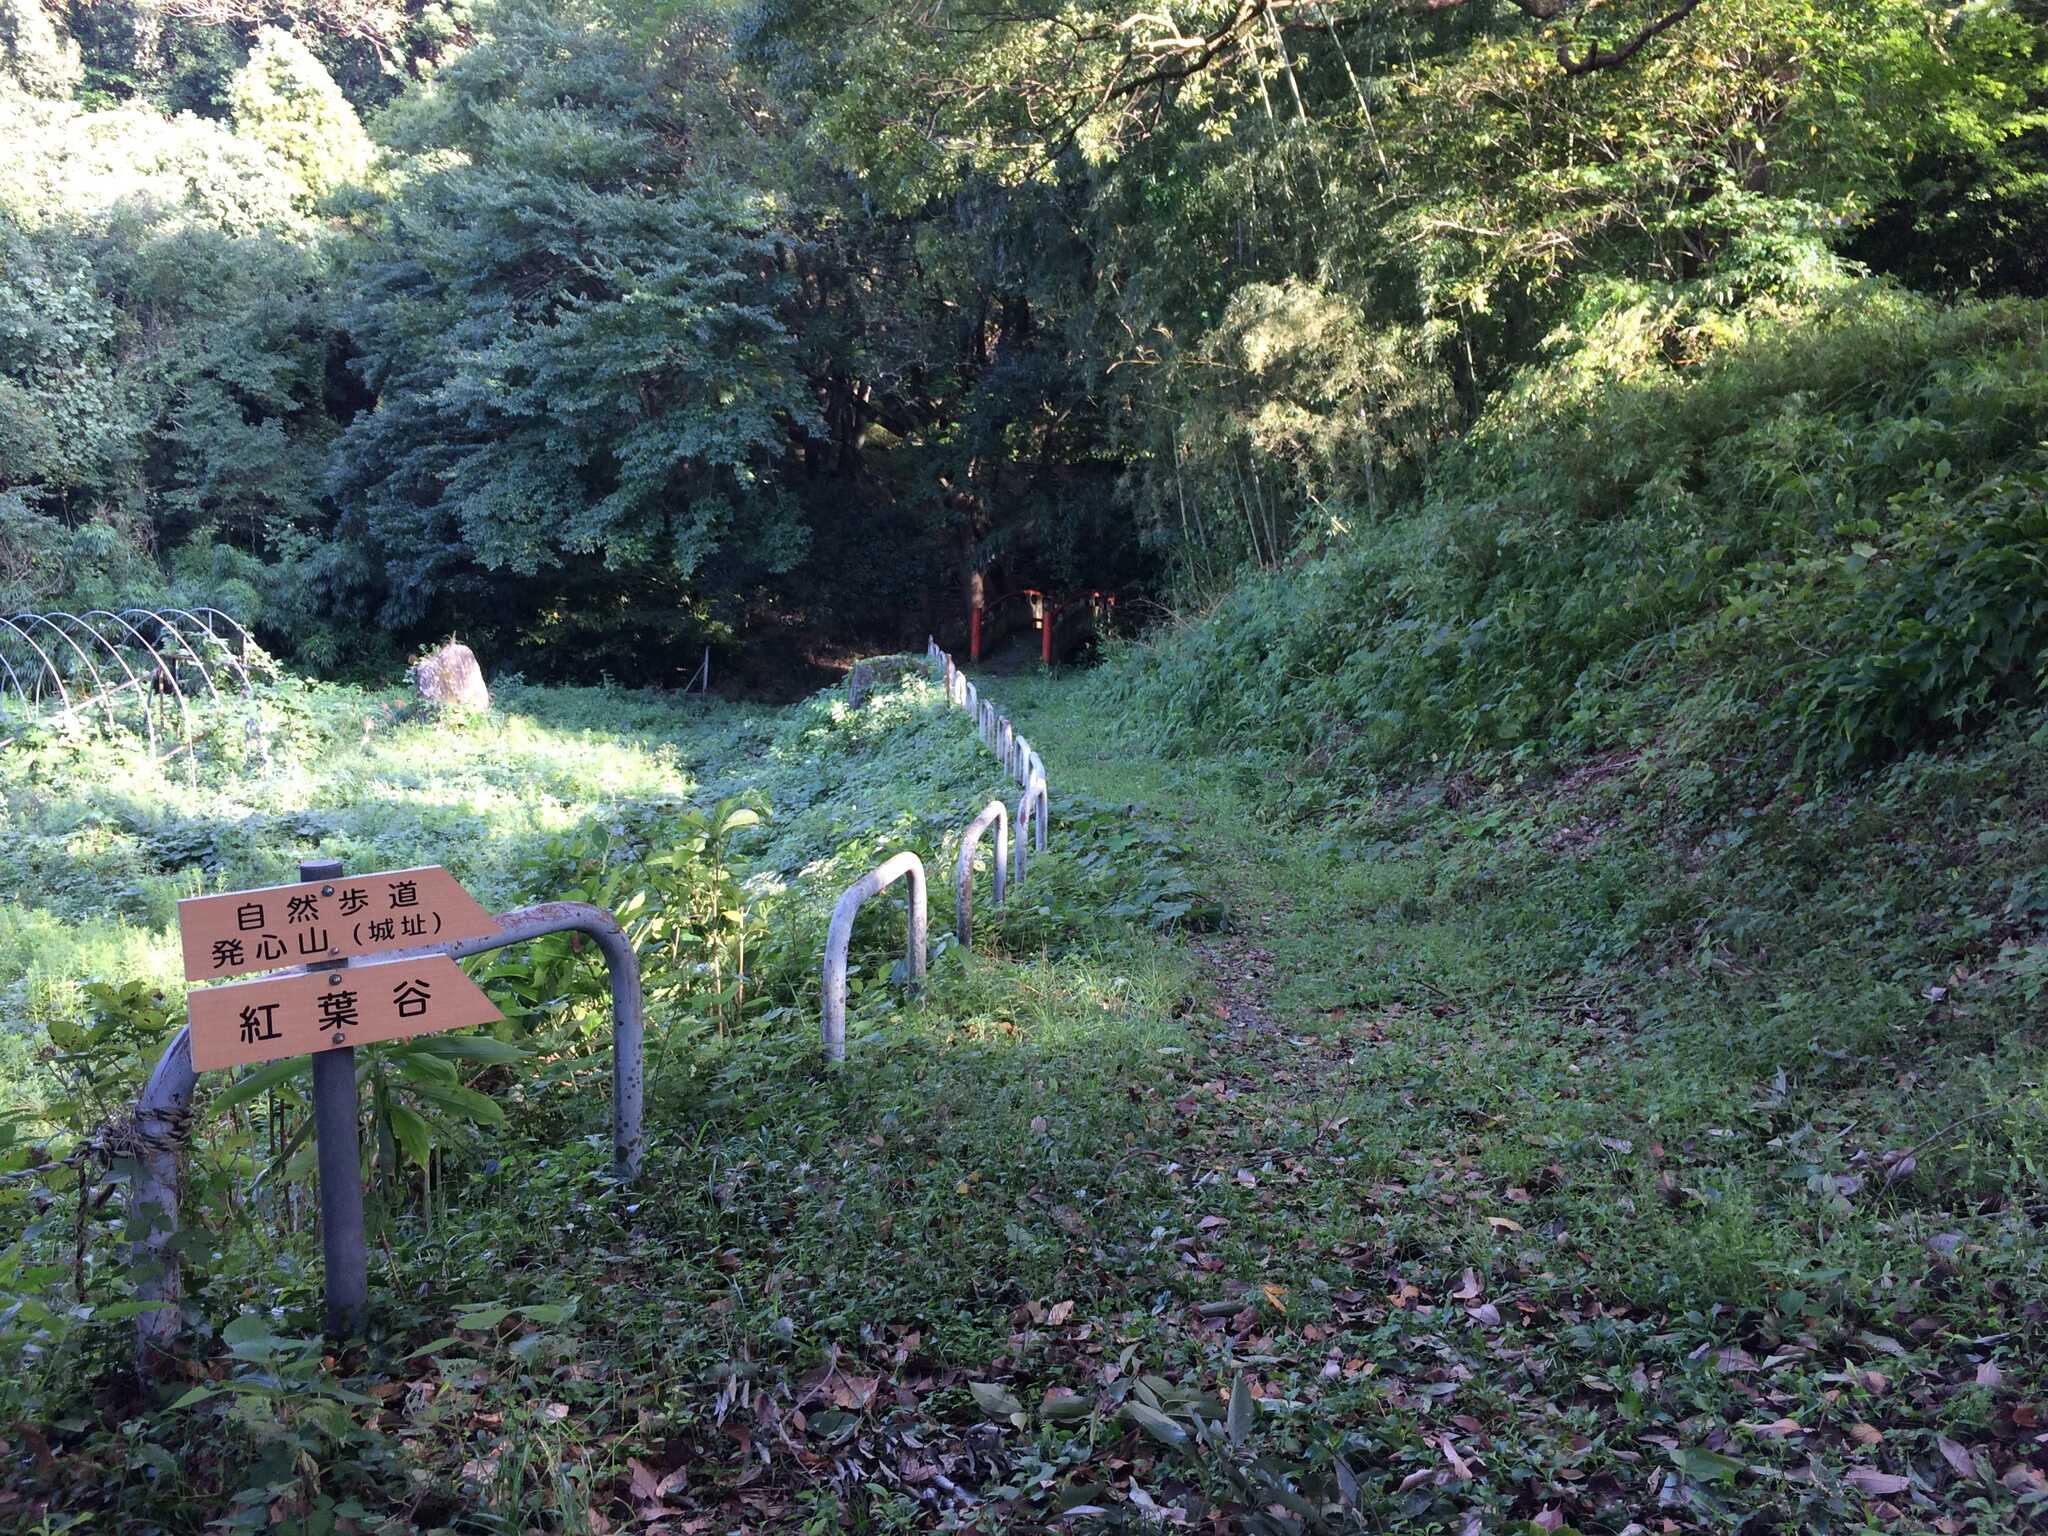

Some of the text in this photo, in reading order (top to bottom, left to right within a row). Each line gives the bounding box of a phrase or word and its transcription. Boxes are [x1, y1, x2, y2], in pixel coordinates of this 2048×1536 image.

[237, 880, 419, 931] 自然歩道
[239, 979, 431, 1044] 紅葉谷
